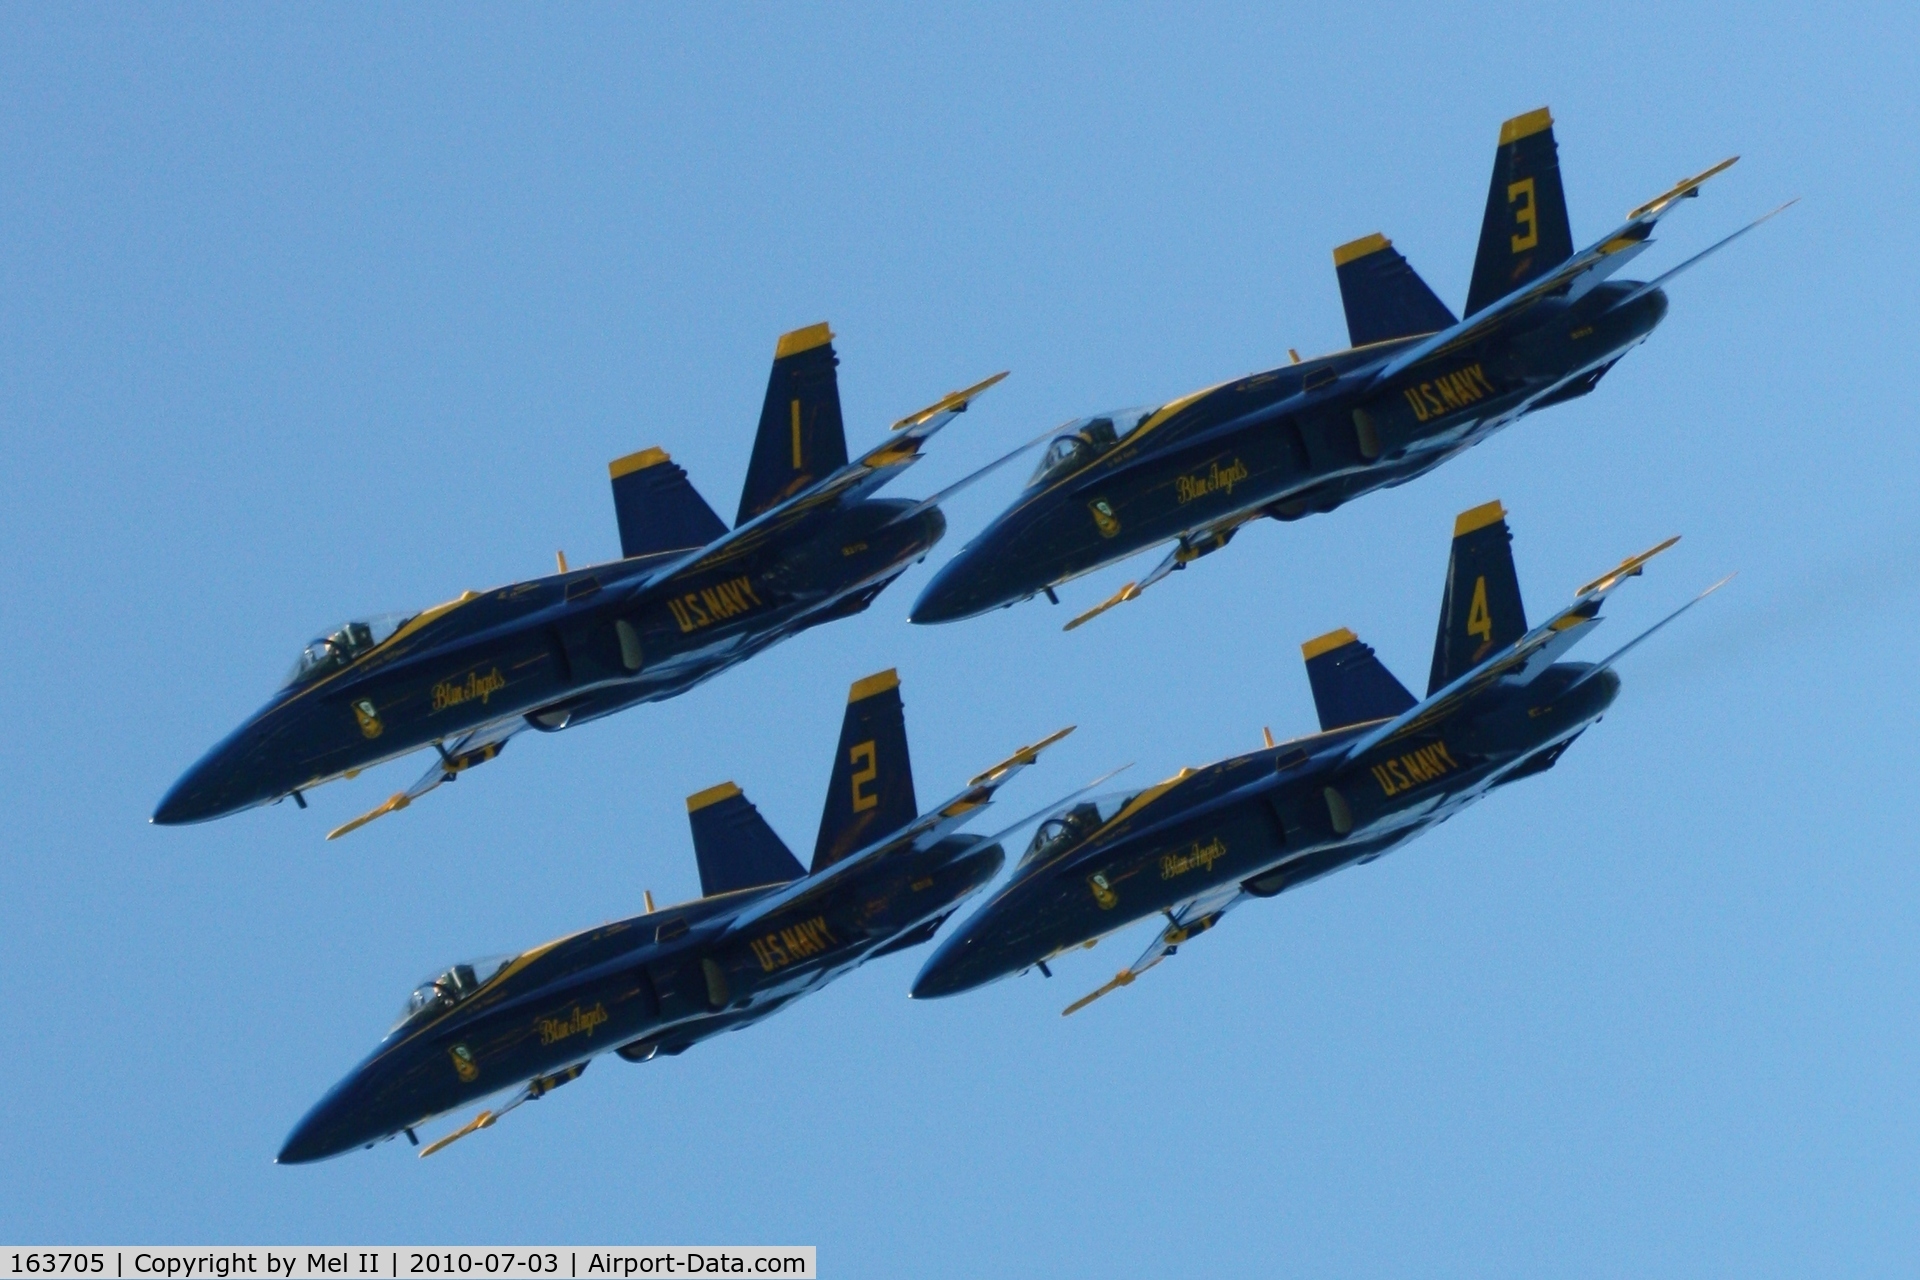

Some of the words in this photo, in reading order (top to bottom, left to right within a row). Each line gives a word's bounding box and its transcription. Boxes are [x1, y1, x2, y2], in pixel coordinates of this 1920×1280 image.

[1507, 176, 1539, 253] 3
[1434, 363, 1495, 408] NAVY
[790, 398, 802, 469] 1
[1176, 476, 1208, 504] Blue
[1208, 458, 1248, 495] Angels
[700, 575, 762, 620] NAVY
[1467, 575, 1492, 642] 4
[432, 683, 464, 710] Blue
[463, 667, 505, 704] Angels
[849, 739, 879, 813] 2
[1401, 740, 1458, 782] NAVY
[1160, 855, 1190, 880] Blue
[1189, 837, 1227, 872] Angels
[780, 915, 838, 959] NAVY
[540, 1020, 570, 1045] Blue
[569, 1002, 608, 1037] Angels
